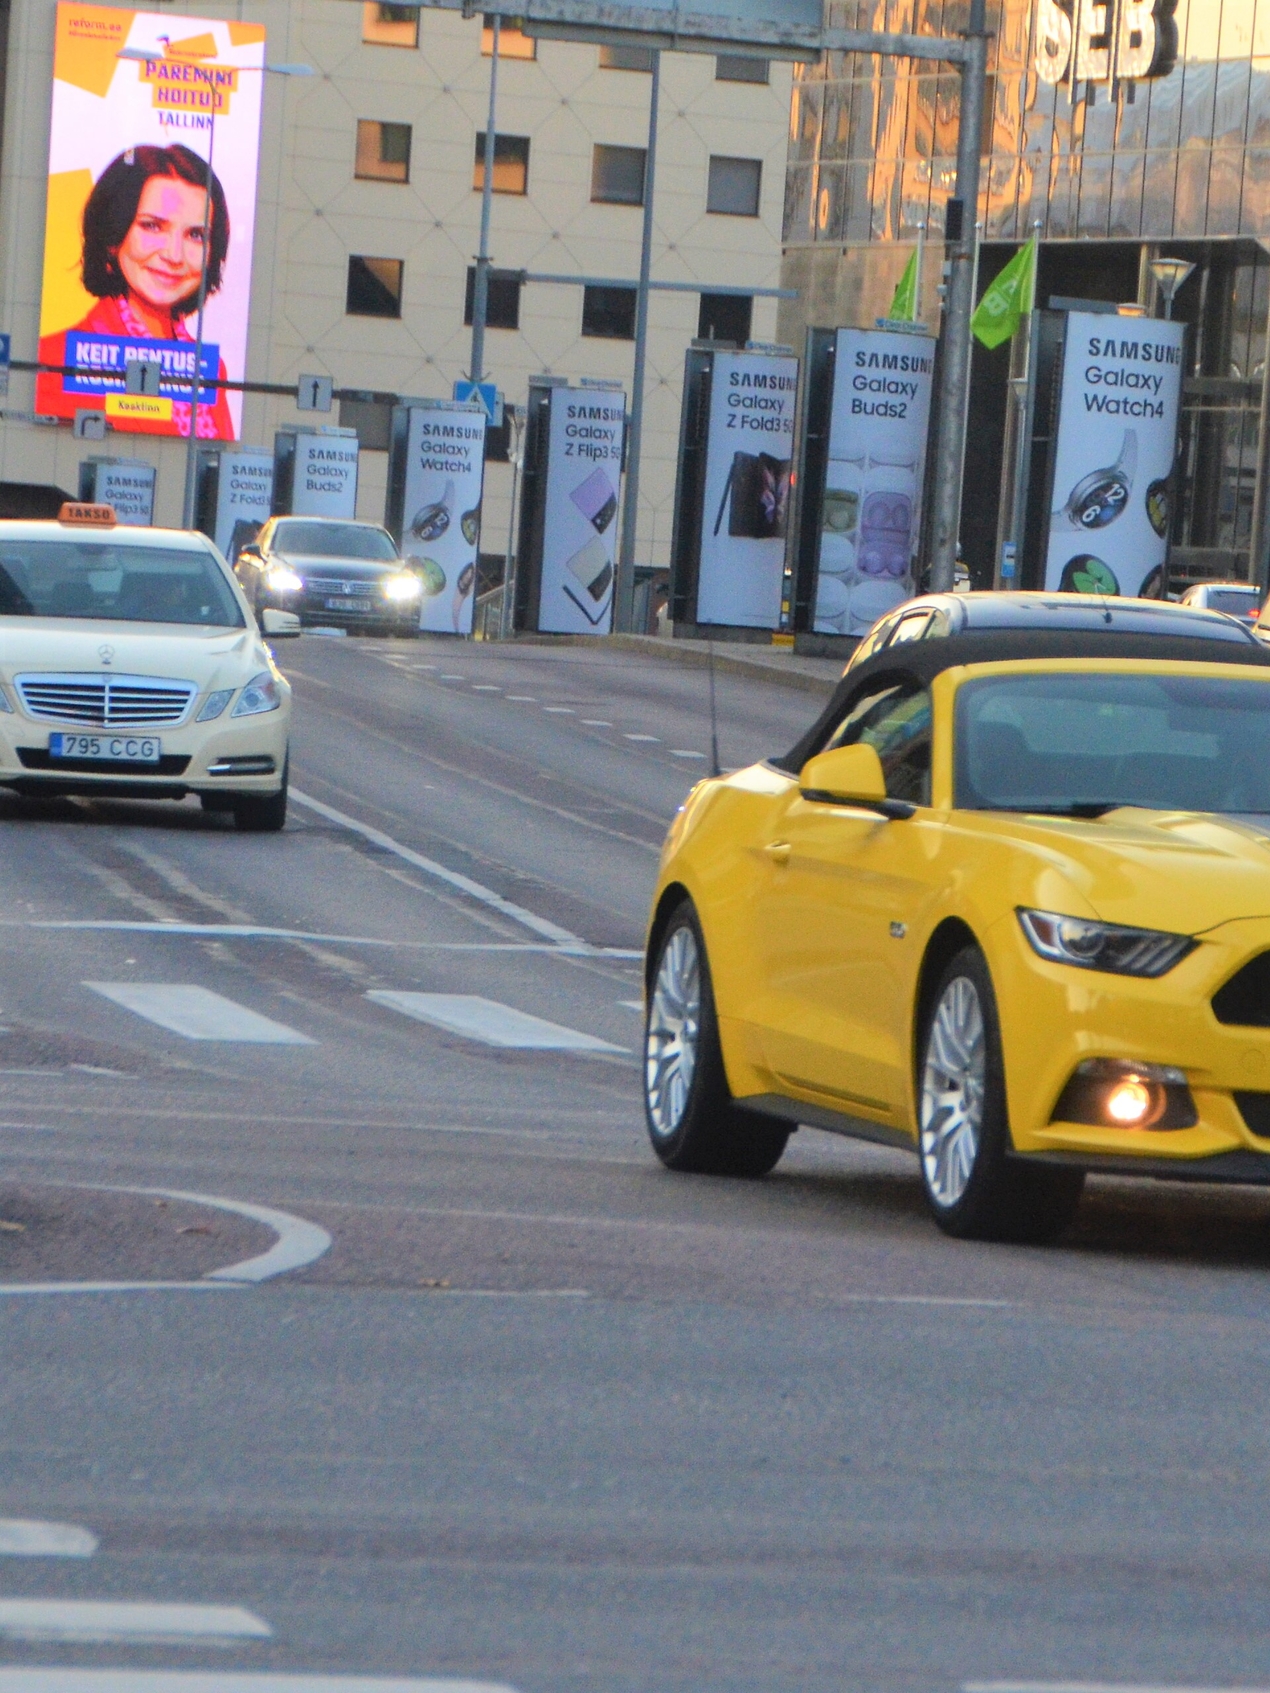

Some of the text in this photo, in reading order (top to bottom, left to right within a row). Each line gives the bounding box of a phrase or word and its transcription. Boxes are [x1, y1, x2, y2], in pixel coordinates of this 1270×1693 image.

[76, 341, 120, 364] KEIT
[730, 371, 796, 392] SAMSUN
[852, 374, 918, 400] Galaxy
[1085, 366, 1163, 396] Galaxy
[567, 405, 624, 421] SAMSUN
[727, 393, 785, 415] Galaxy
[851, 398, 907, 419] Buds2
[1084, 393, 1164, 418] Watch4
[565, 423, 616, 443] Galaxy
[726, 413, 737, 428] Z
[741, 415, 781, 433] Fold3
[421, 440, 469, 459] Galaxy
[564, 442, 574, 456] Z
[578, 443, 609, 461] Flip3
[307, 463, 348, 480] Galaxy
[421, 458, 472, 472] Watch4
[306, 479, 343, 492] Buds2
[1105, 483, 1125, 505] 12
[68, 507, 110, 520] TAKSO
[1082, 505, 1101, 522] 6
[66, 737, 154, 758] 795 CCG
